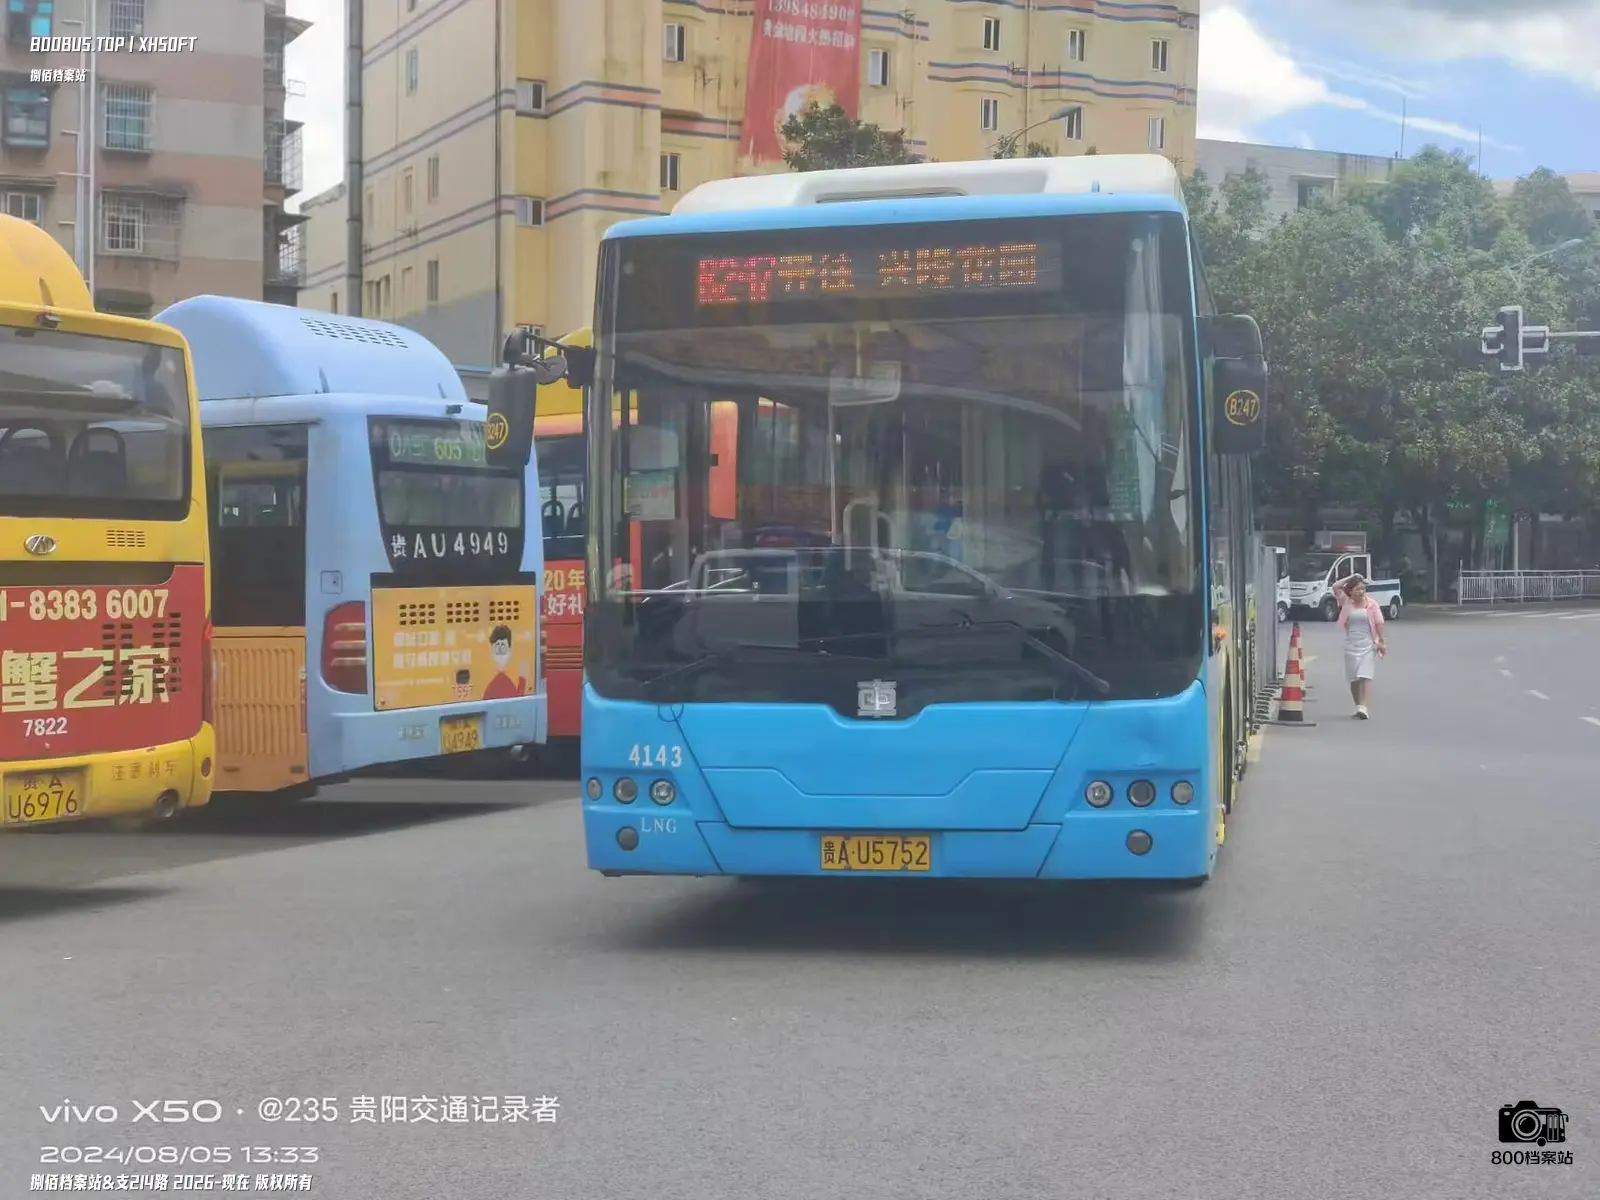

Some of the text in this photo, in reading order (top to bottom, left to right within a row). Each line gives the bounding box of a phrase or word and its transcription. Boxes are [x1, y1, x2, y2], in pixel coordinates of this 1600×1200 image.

[106, 589, 169, 619] 6007
[544, 592, 584, 616] 好礼
[2, 646, 170, 713] 蟹之家
[23, 717, 68, 737] 7822
[628, 744, 683, 768] 4143
[8, 789, 78, 820] U6976
[641, 817, 677, 834] LNG
